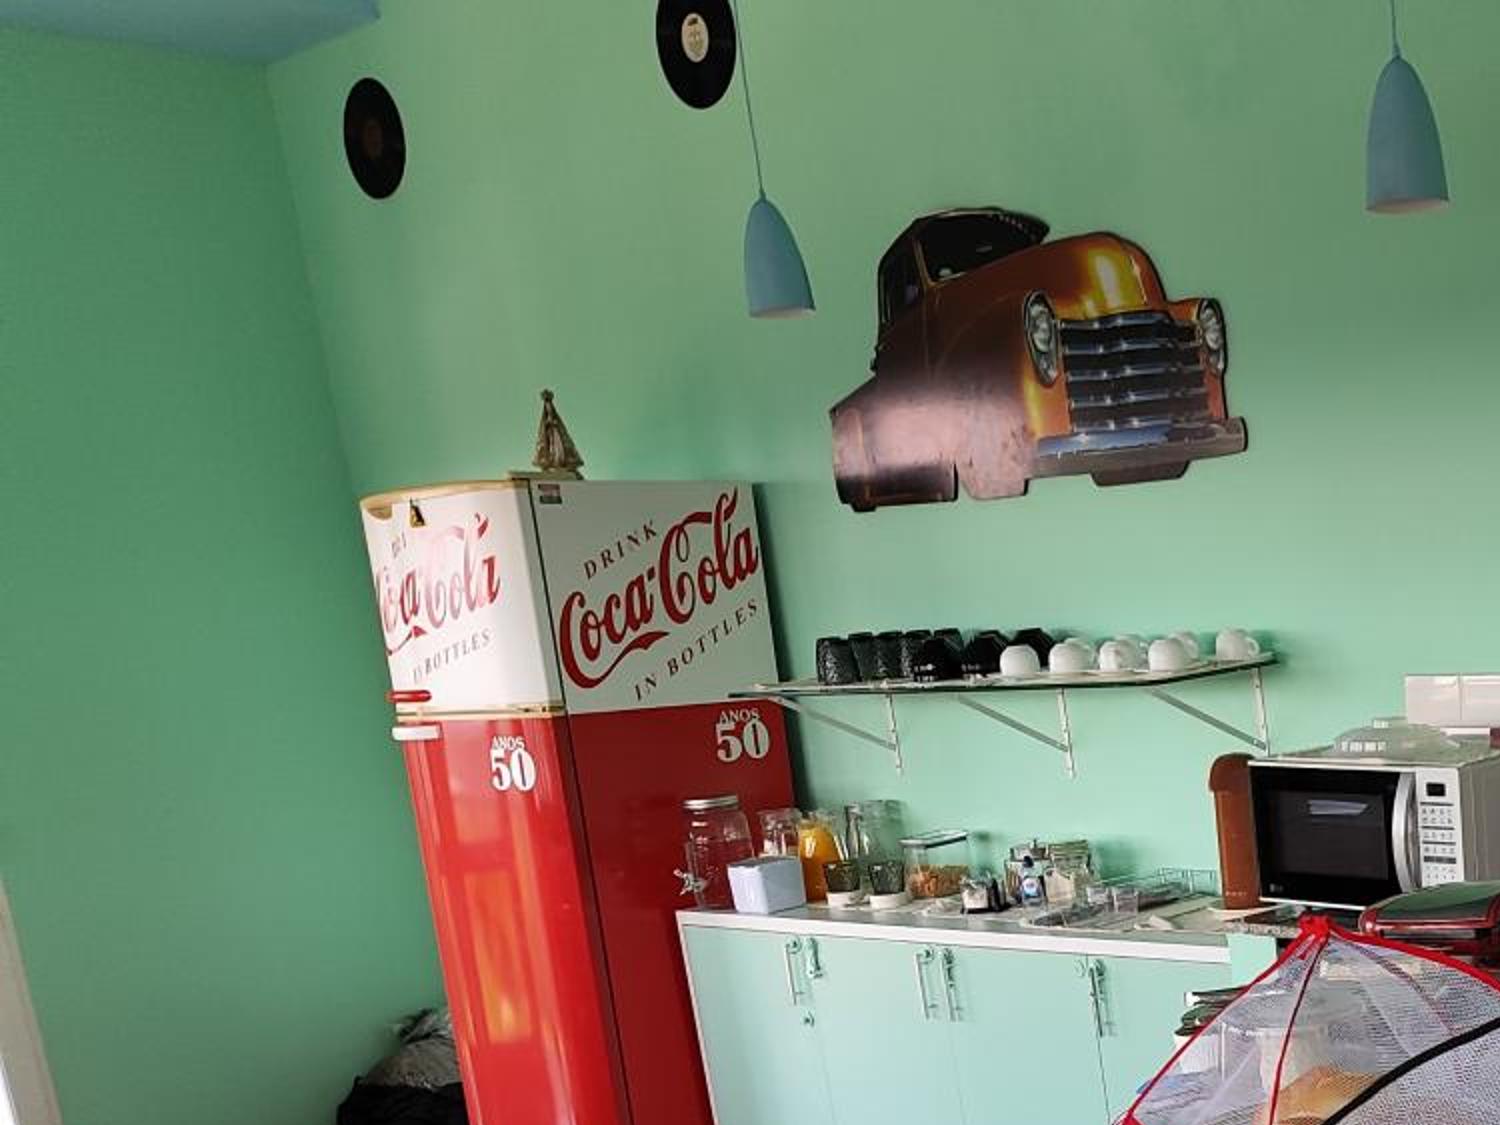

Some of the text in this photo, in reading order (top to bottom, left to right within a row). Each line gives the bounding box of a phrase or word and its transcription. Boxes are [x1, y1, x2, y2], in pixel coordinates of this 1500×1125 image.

[583, 520, 658, 580] DRINK
[559, 486, 759, 689] Coca-Cola
[425, 628, 491, 676] BOTTLES
[633, 598, 758, 701] IN BOTTLES
[719, 707, 761, 725] ANOS
[492, 735, 525, 751] ANOS
[715, 720, 770, 763] 50
[489, 748, 537, 792] 50
